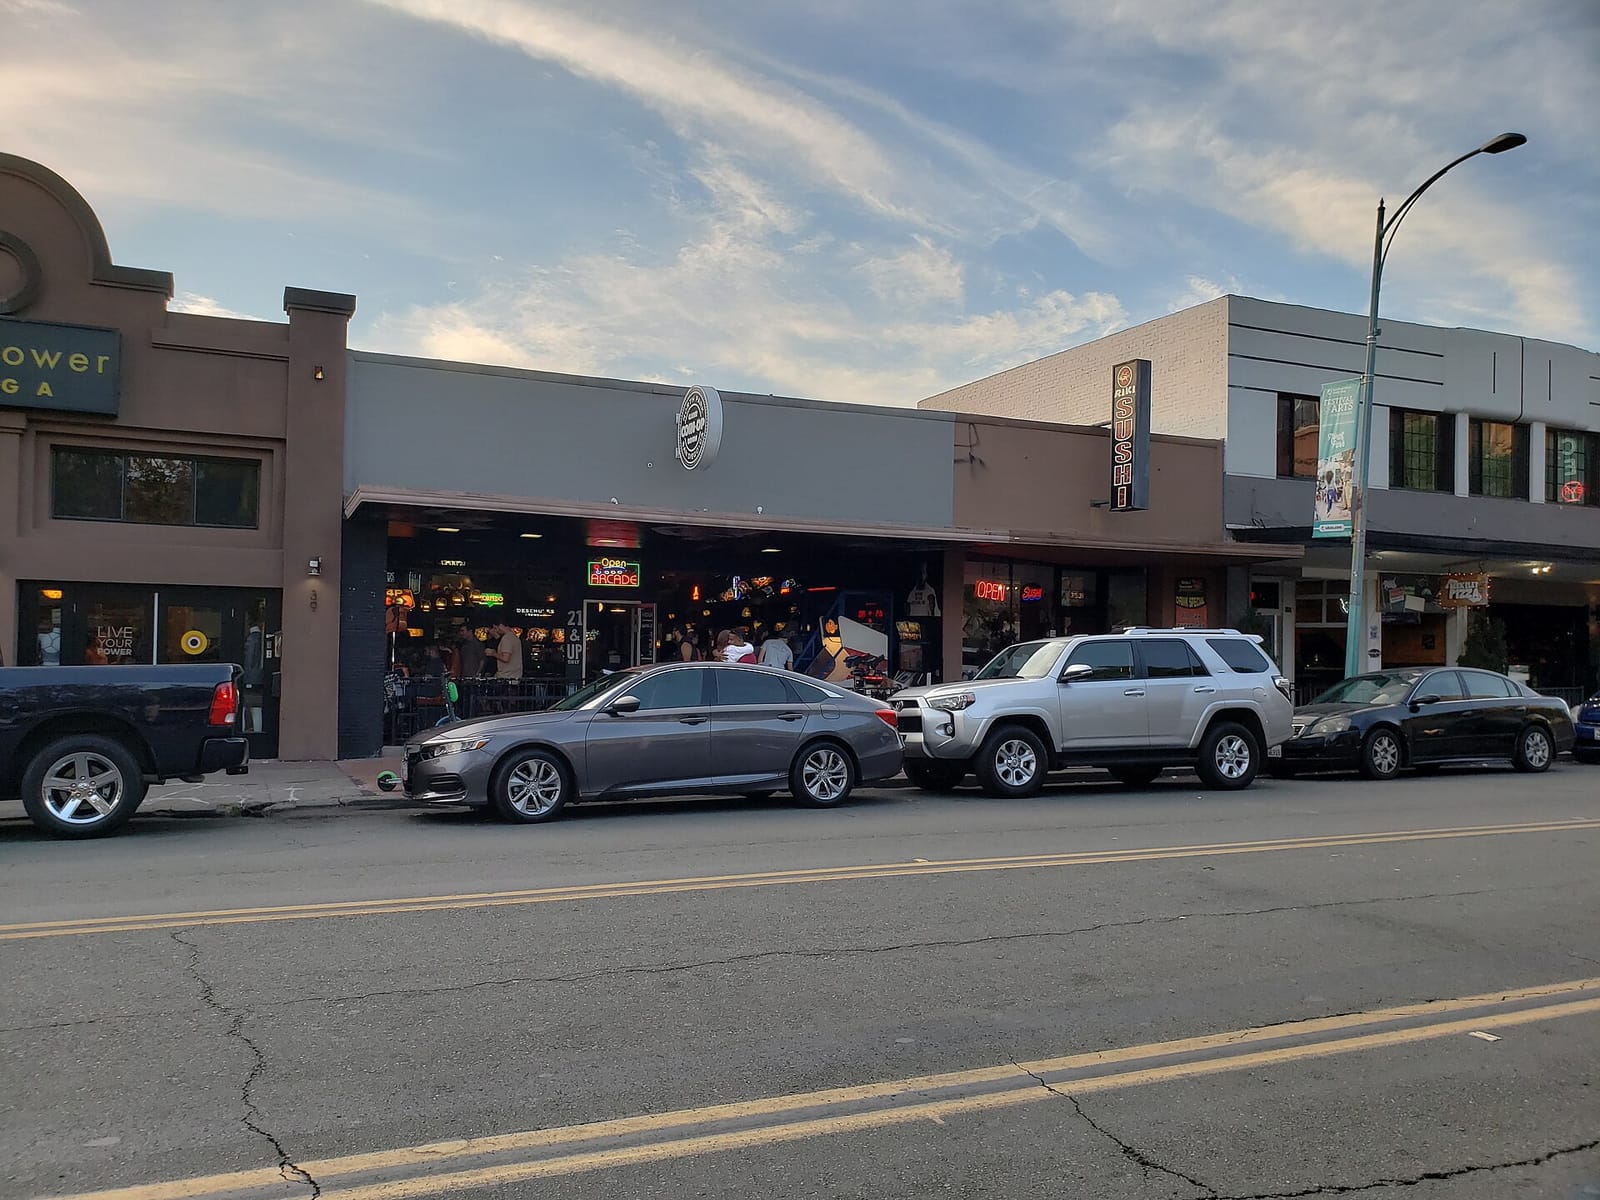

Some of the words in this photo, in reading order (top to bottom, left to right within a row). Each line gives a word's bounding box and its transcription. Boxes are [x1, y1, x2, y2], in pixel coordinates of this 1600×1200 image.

[2, 346, 110, 374] ower
[1114, 385, 1136, 398] RIKI
[1114, 397, 1133, 508] SUSHI
[601, 558, 627, 568] Open
[591, 574, 637, 585] ARCADE
[977, 581, 1006, 601] OPEN
[1449, 588, 1482, 602] PIZZA
[567, 610, 583, 626] 21
[97, 626, 133, 638] LIVE
[569, 628, 580, 642] &
[96, 638, 133, 648] YOUR
[97, 648, 132, 656] POWER
[566, 643, 582, 660] UP
